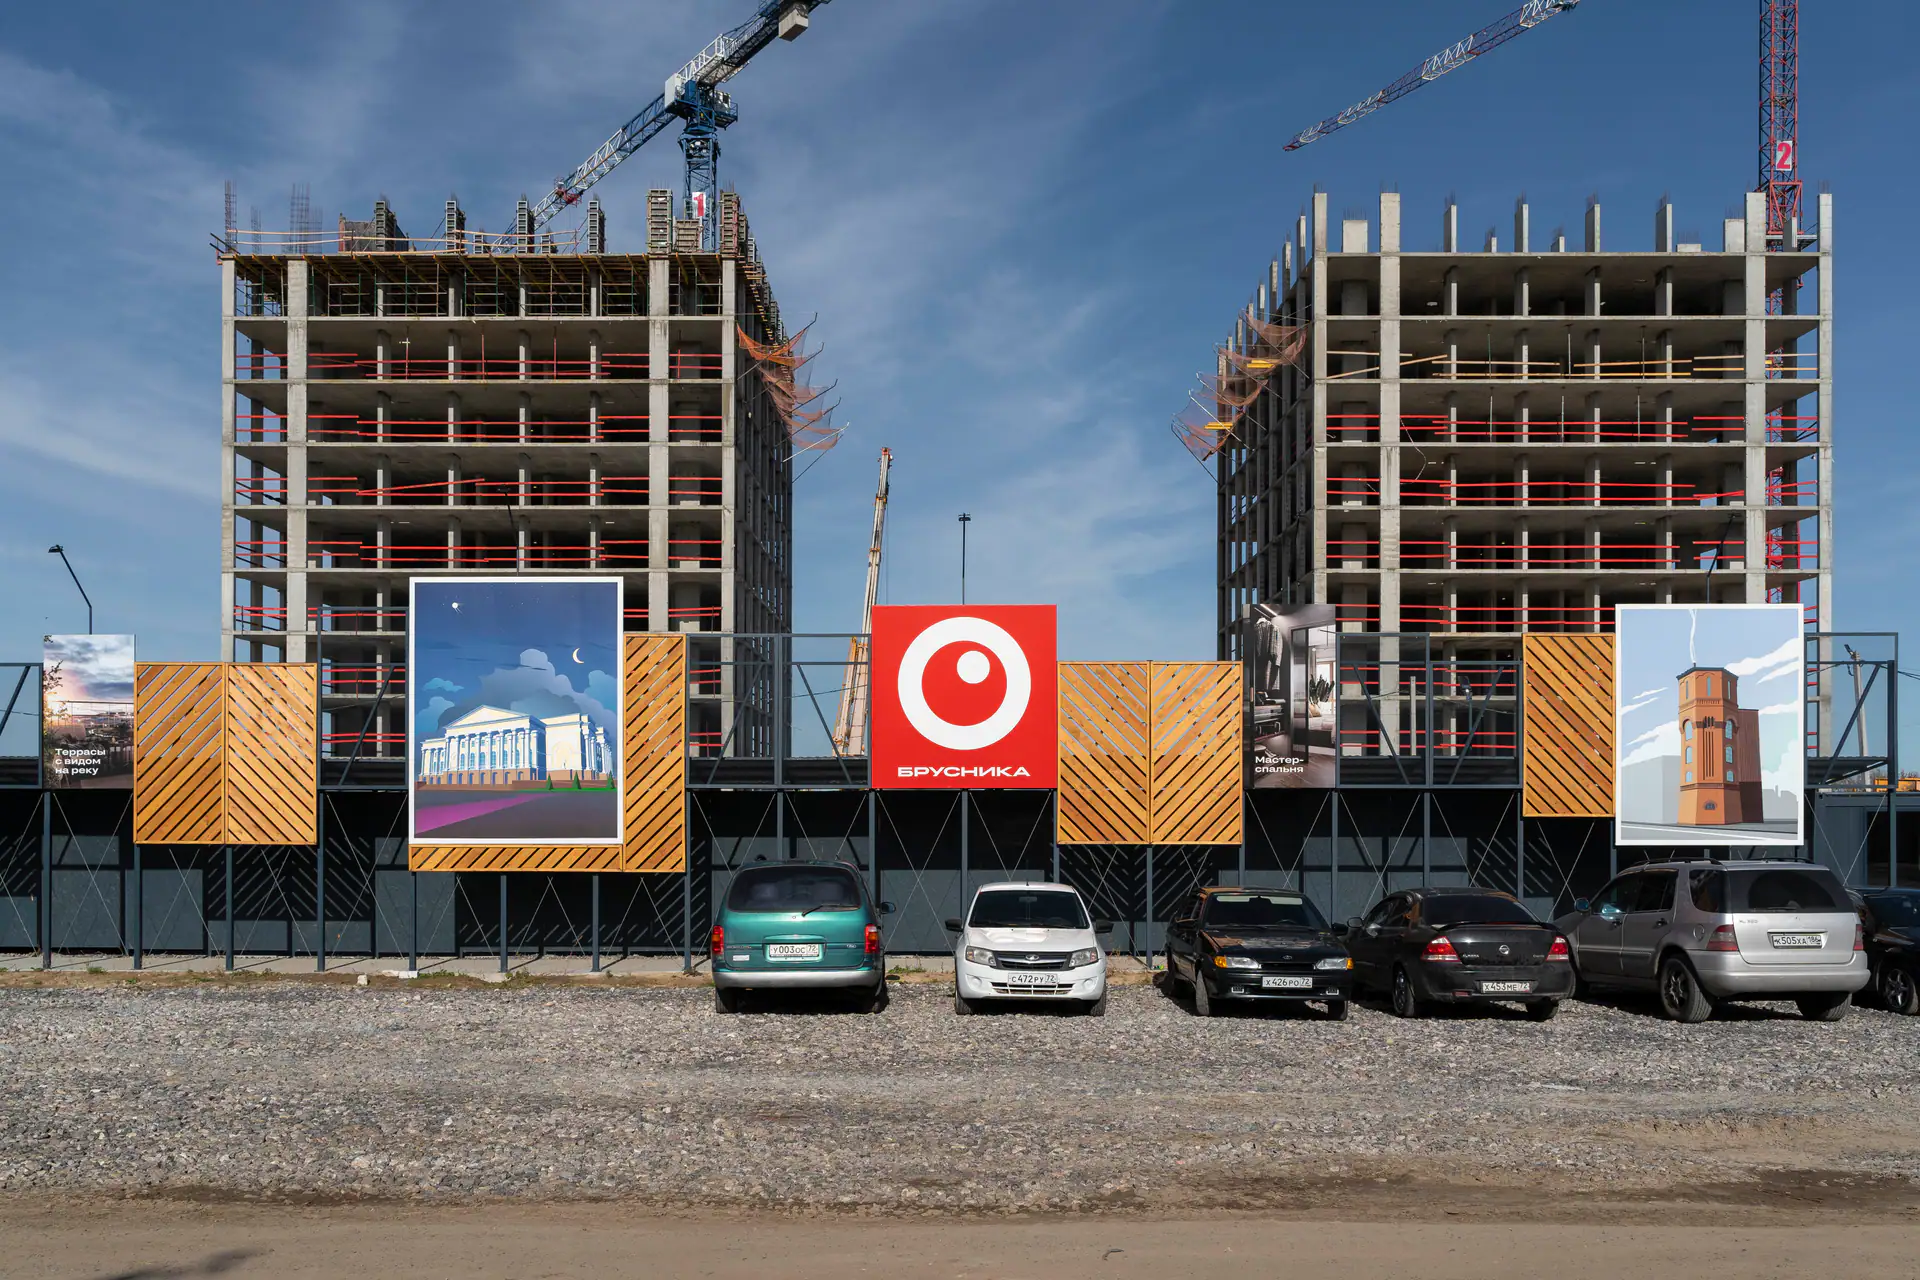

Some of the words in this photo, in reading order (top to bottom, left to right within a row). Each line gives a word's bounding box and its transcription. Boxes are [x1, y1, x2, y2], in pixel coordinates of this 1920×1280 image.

[1777, 142, 1792, 169] 2
[693, 193, 705, 217] 1
[55, 748, 106, 757] Террасы
[64, 758, 101, 766] видом
[1255, 756, 1304, 765] Мастер-
[71, 767, 99, 776] реку
[897, 766, 1031, 777] БРУСНИКА
